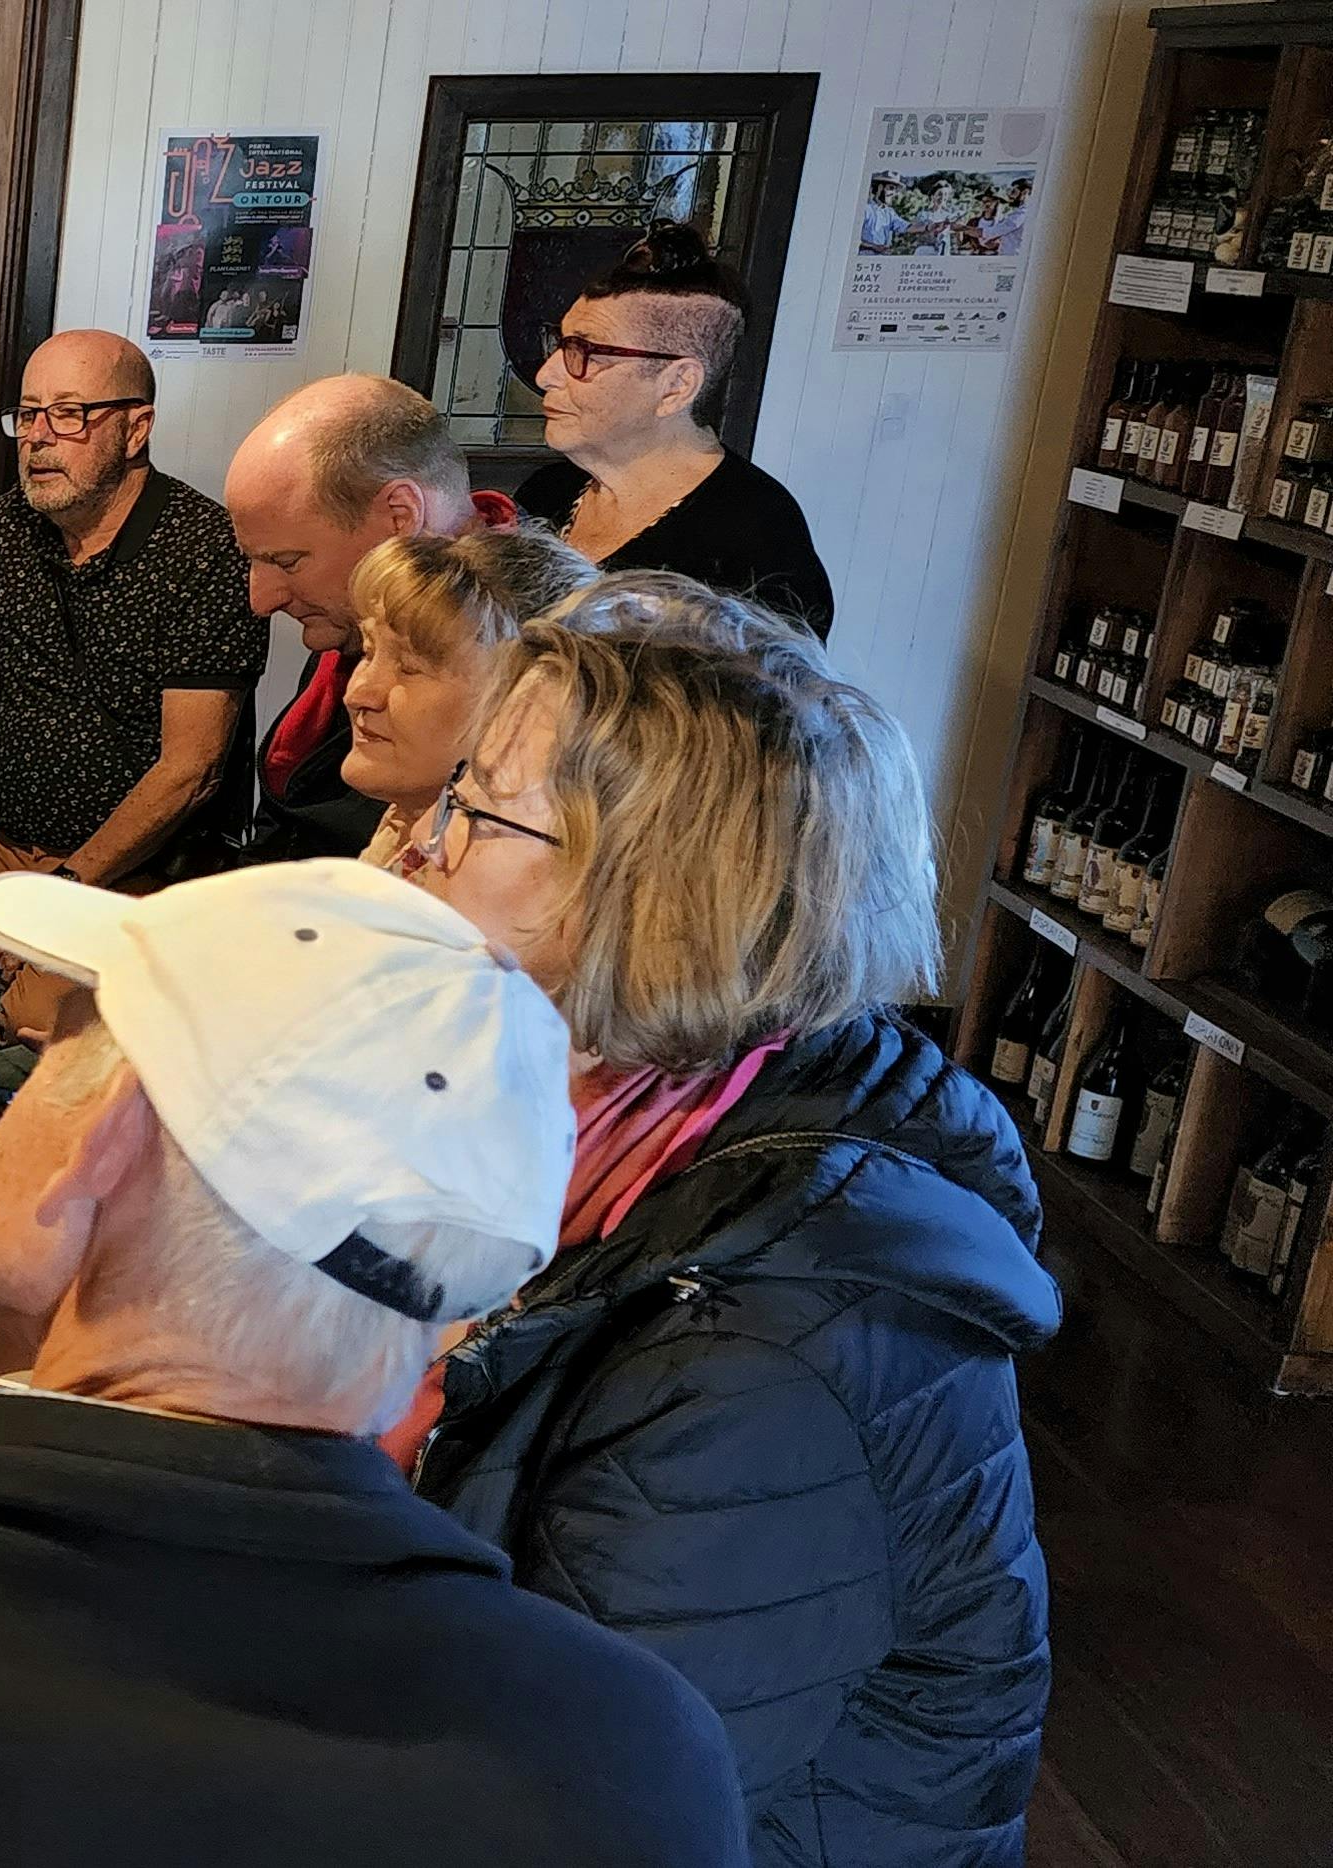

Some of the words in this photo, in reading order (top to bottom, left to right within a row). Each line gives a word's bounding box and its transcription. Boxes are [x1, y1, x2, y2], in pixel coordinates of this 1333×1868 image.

[882, 112, 989, 146] TASTE
[878, 149, 916, 159] GREAT
[920, 149, 983, 159] SOUTHERN
[238, 158, 303, 179] Jazz
[244, 180, 301, 190] FESTIVAL
[240, 194, 260, 204] ON
[266, 194, 303, 204] TOUR
[853, 273, 881, 283] MAY
[851, 284, 881, 293] 2022
[202, 347, 227, 355] TASTE
